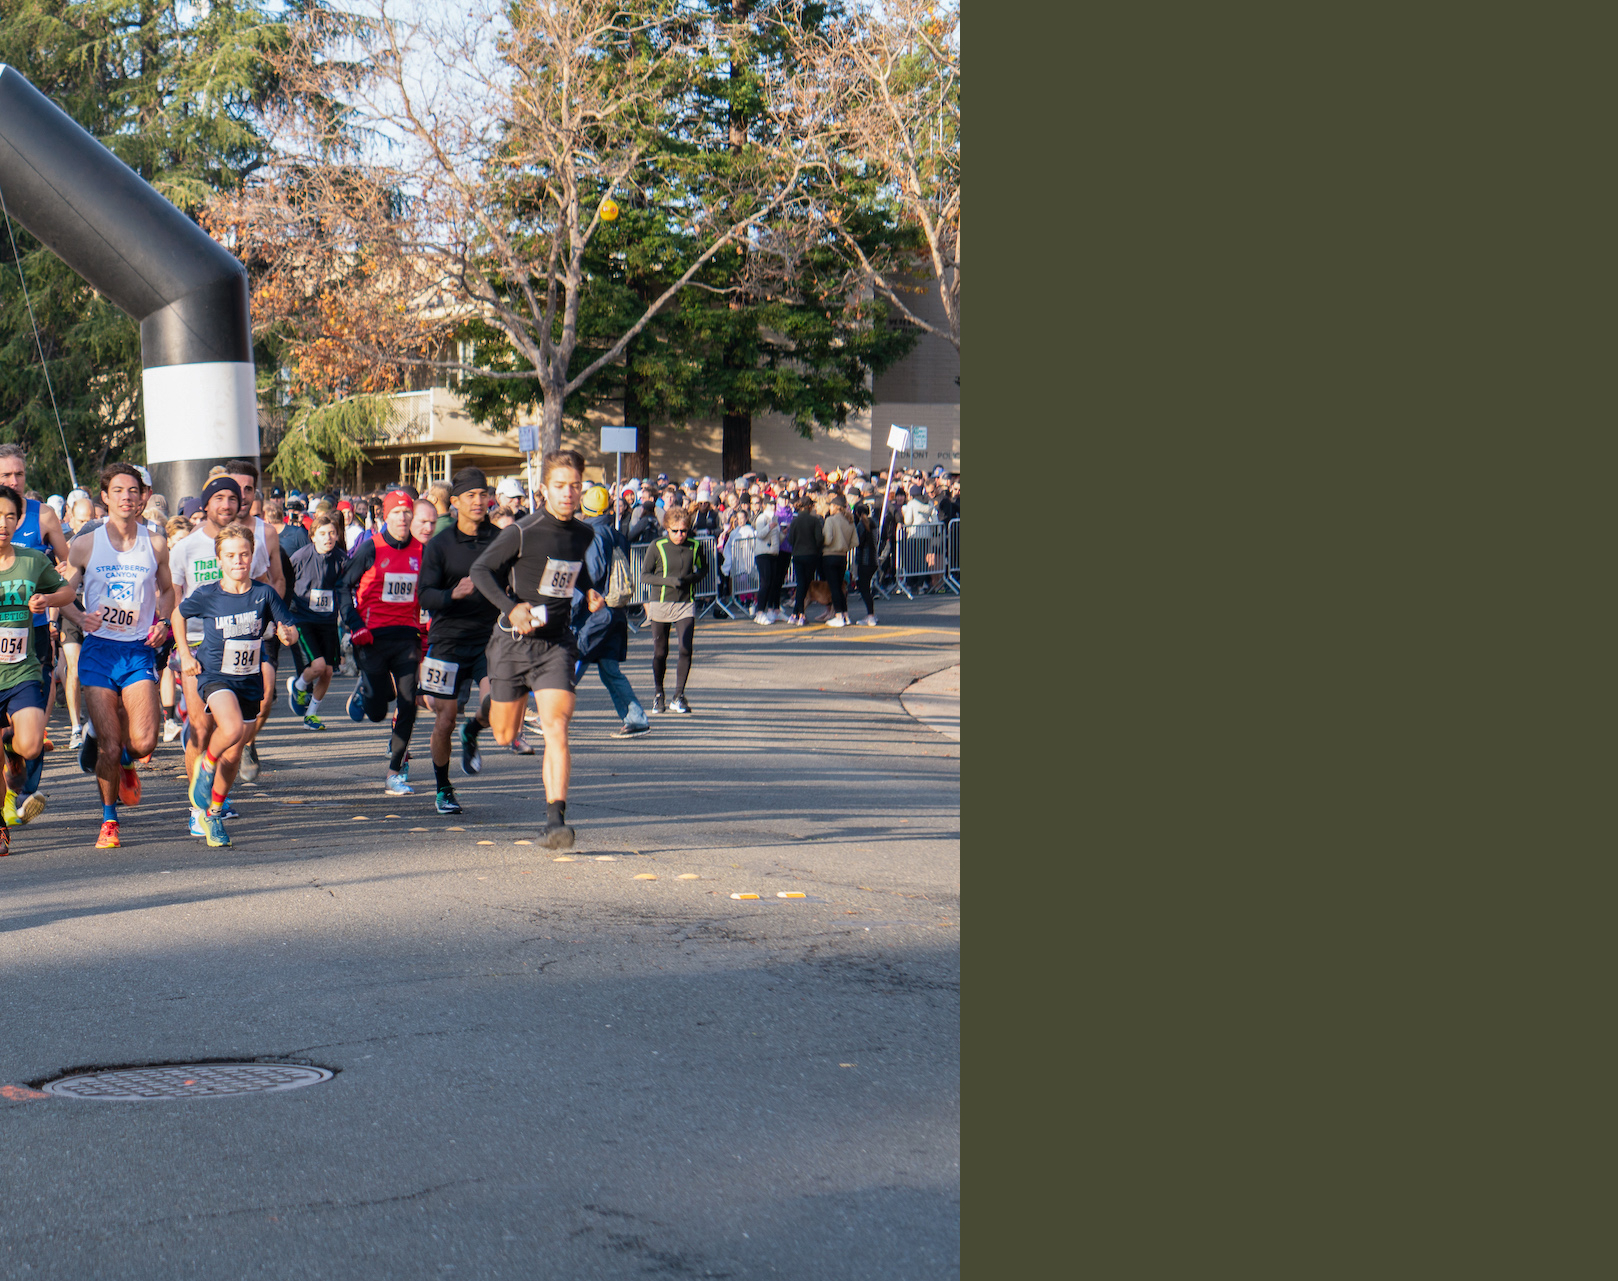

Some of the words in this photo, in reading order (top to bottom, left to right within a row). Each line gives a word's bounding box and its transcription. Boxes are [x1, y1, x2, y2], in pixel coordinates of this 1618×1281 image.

[95, 564, 150, 574] STRAWBERRY
[105, 571, 137, 579] CANYON
[387, 582, 413, 595] 1089
[102, 606, 134, 626] 2206
[233, 650, 255, 666] 384
[426, 667, 448, 686] 534
